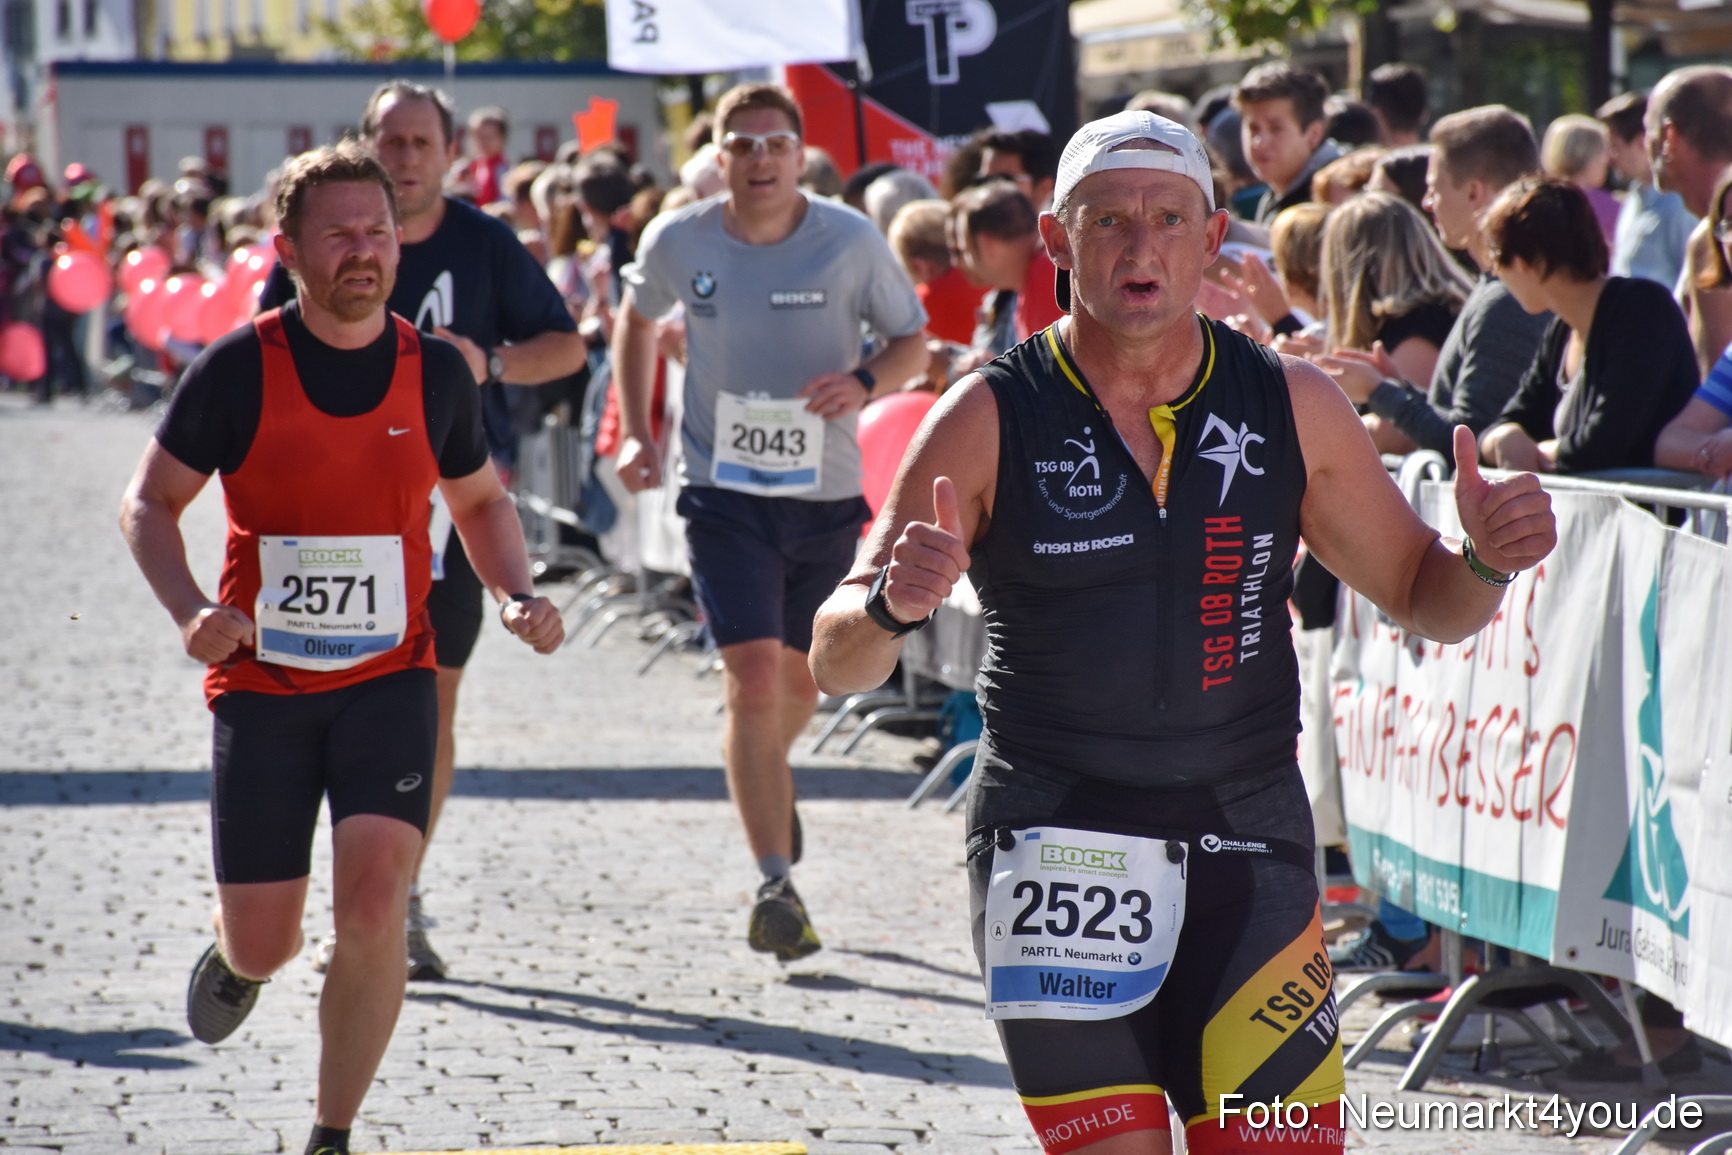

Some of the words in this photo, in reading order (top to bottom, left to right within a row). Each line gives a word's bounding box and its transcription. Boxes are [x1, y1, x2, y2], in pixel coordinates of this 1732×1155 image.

[731, 423, 806, 457] 2043
[1034, 462, 1058, 473] TSG
[1060, 461, 1075, 473] 08
[1038, 478, 1049, 499] Turn-
[1048, 500, 1064, 514] und
[1064, 473, 1128, 521] Sportgemeinschaft
[1069, 485, 1103, 497] ROTH
[300, 549, 363, 564] BOCK
[1202, 516, 1243, 585] ROTH
[278, 575, 375, 615] 2571
[1240, 533, 1274, 663] TRIATHLON
[1200, 593, 1233, 626] 08
[286, 619, 317, 630] PARTL
[319, 623, 362, 631] Neumarkt
[305, 638, 356, 656] Oliver
[1202, 635, 1235, 691] TSG
[1041, 844, 1128, 871] BOCK
[1222, 840, 1267, 849] CHALLENGE
[1040, 865, 1067, 873] inspired
[1068, 866, 1076, 874] by
[1099, 871, 1128, 879] concepts
[1012, 880, 1153, 944] 2523
[995, 925, 1002, 936] A
[1021, 946, 1061, 958] PARTL
[1065, 948, 1123, 963] Neumarkt
[1039, 972, 1117, 999] Walter
[1249, 981, 1315, 1034] TSG
[1303, 952, 1331, 991] 08
